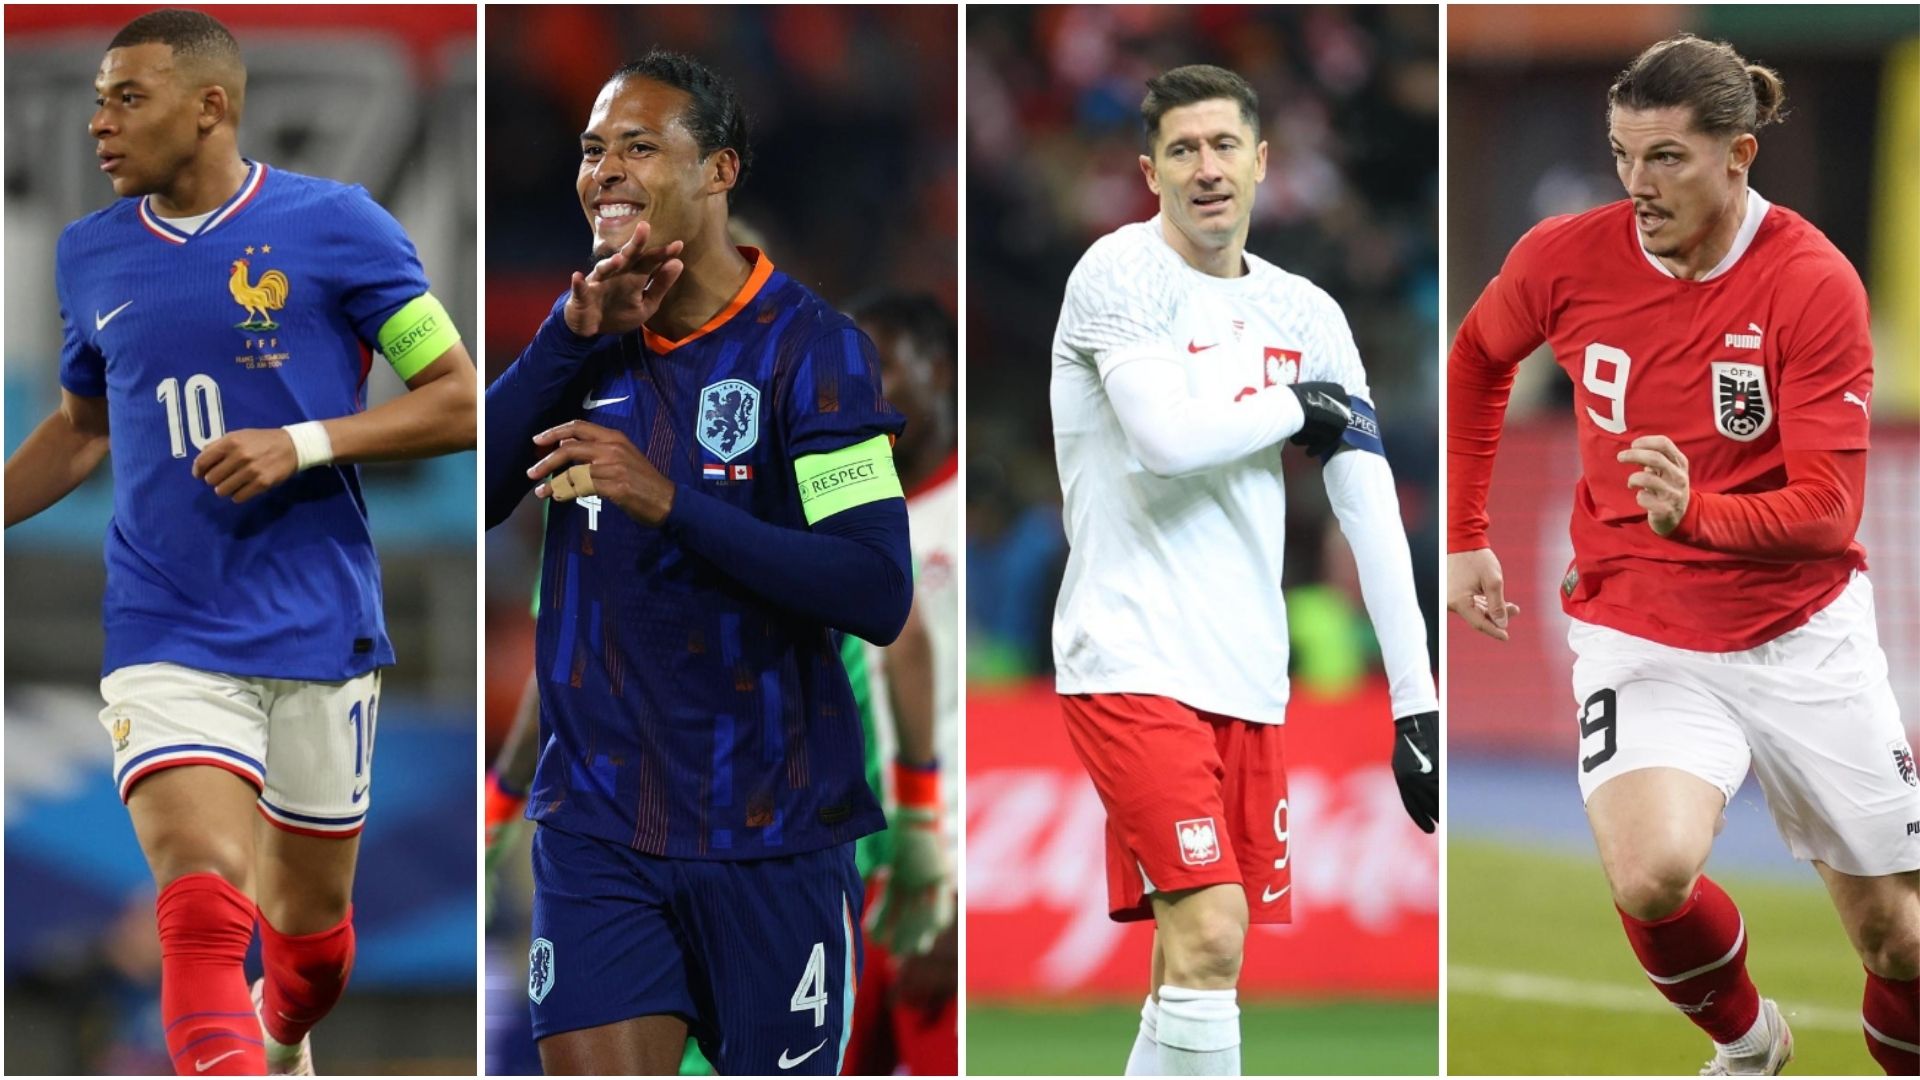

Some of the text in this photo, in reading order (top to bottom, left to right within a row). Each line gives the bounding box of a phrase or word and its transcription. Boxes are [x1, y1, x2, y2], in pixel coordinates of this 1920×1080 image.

[389, 316, 437, 357] RESPECT
[1725, 333, 1761, 350] PUMA
[156, 373, 226, 459] 10
[1582, 342, 1631, 435] 9
[1347, 414, 1377, 435] SPECT
[812, 463, 874, 493] RESPECT
[1580, 688, 1617, 773] 9
[1273, 798, 1290, 869] 9
[1906, 821, 1920, 836] PU
[790, 942, 828, 1028] 4
